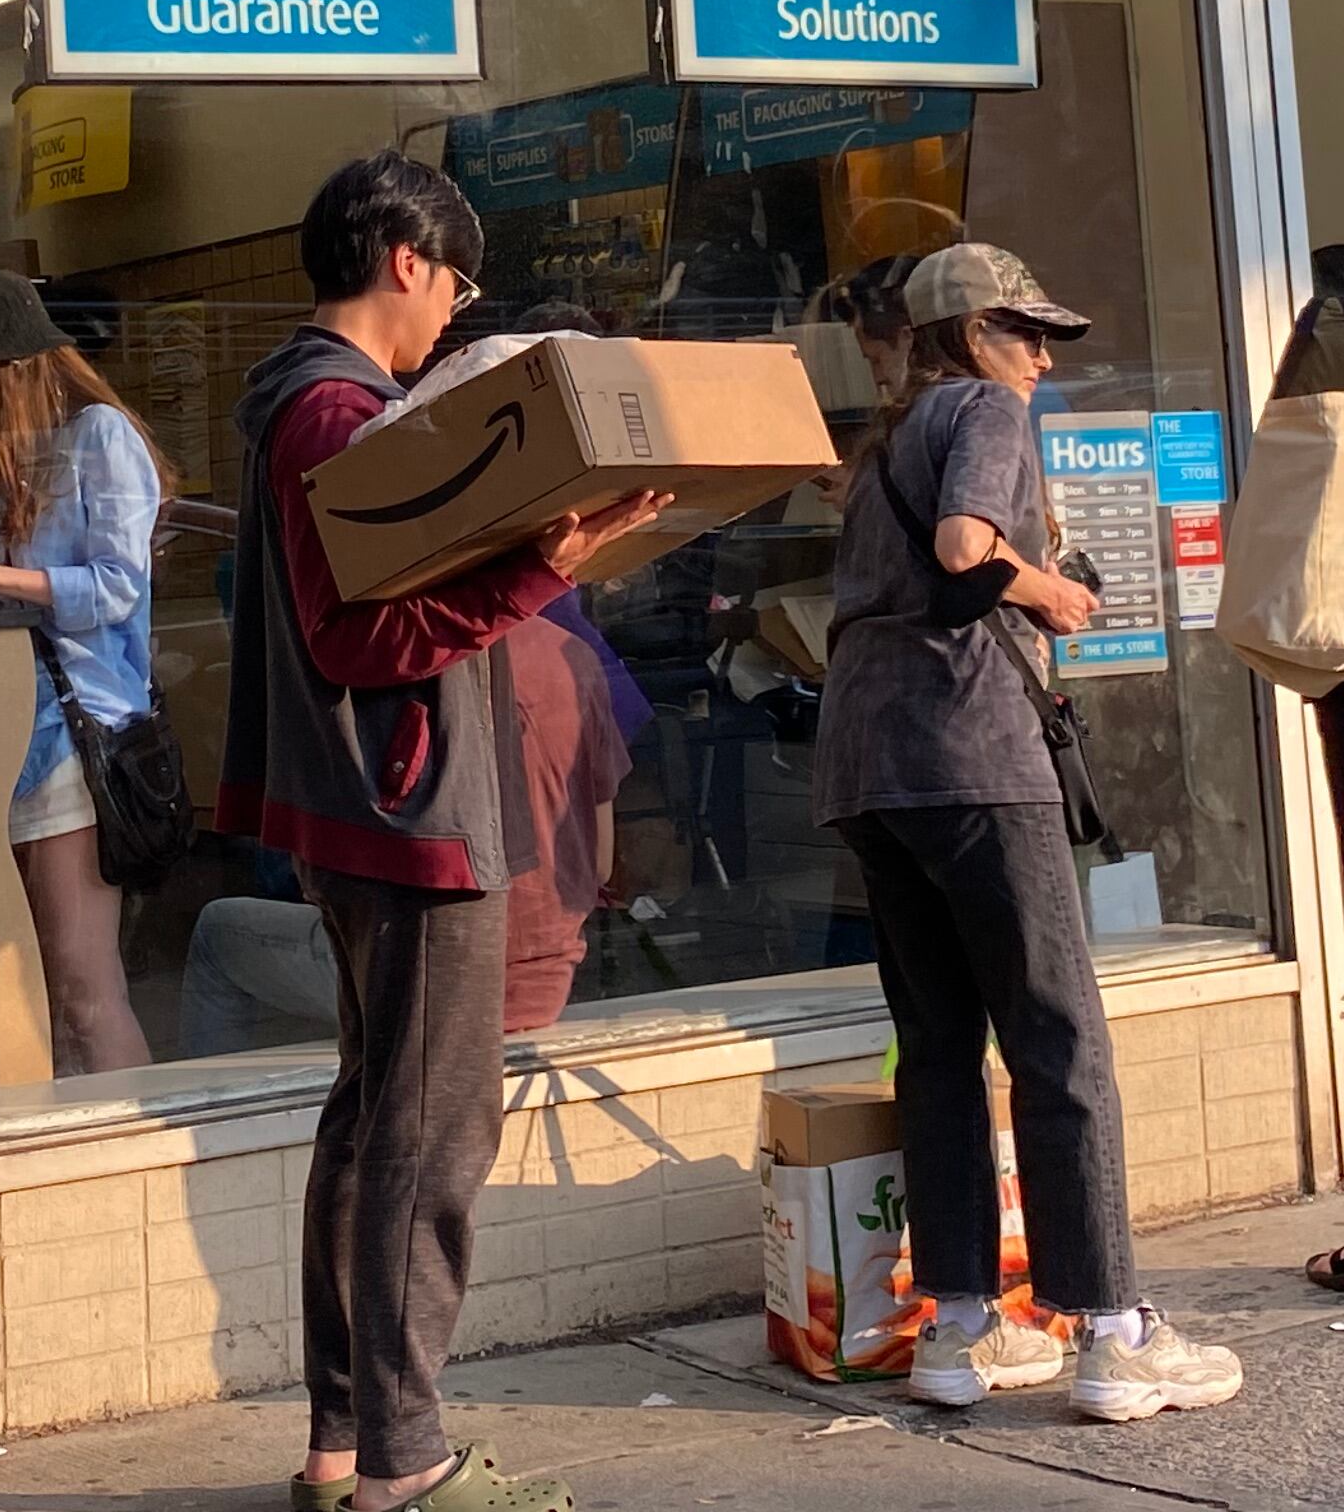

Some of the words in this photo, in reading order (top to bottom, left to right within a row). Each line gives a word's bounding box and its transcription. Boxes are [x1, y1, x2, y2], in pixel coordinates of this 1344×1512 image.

[716, 109, 741, 132] THE
[753, 91, 833, 125] PACKAGING
[465, 157, 488, 177] THE
[496, 146, 548, 172] SUPPLIES
[635, 122, 675, 147] STORE
[47, 164, 86, 190] STORE
[1158, 419, 1182, 433] THE
[1052, 437, 1145, 470] Hours
[1180, 465, 1220, 480] STORE
[1083, 643, 1102, 657] THE
[1104, 641, 1124, 656] UPS
[1126, 639, 1157, 654] STORE
